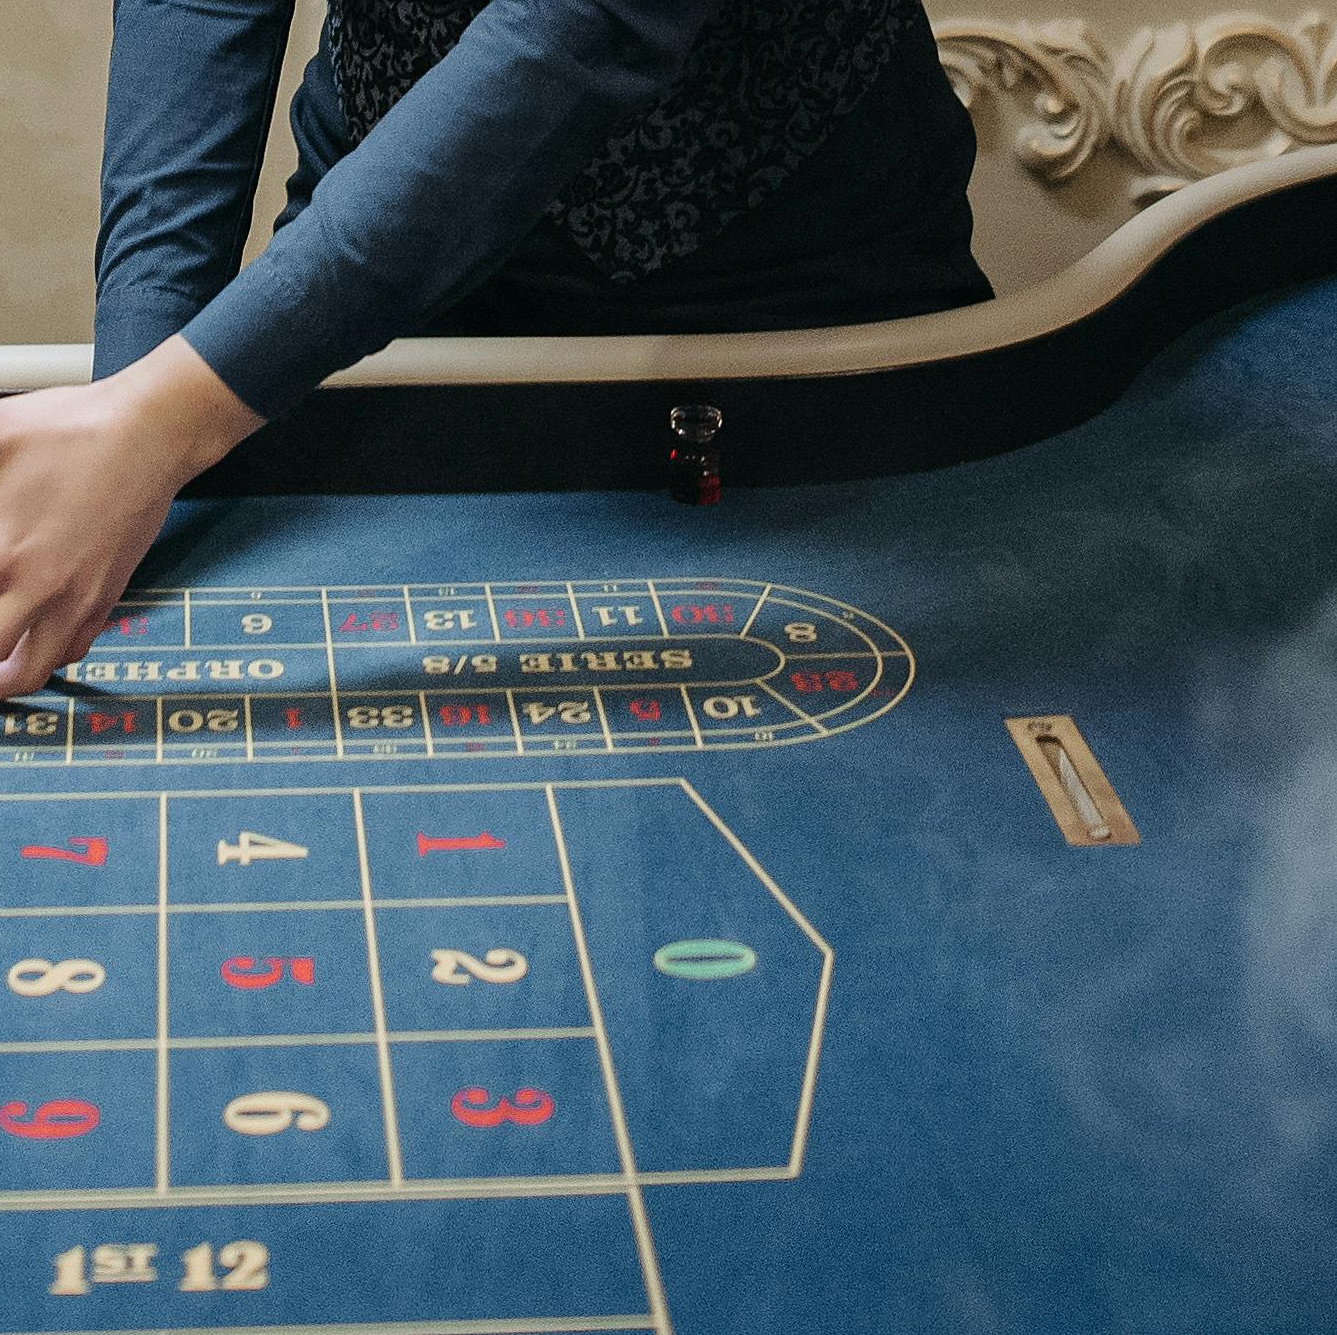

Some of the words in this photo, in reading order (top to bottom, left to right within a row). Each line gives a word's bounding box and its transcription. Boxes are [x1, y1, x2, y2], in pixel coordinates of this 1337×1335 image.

[106, 614, 147, 635] 3
[242, 614, 272, 634] 6
[339, 613, 398, 631] 27
[424, 610, 475, 631] 13
[504, 610, 564, 627] 36
[593, 606, 641, 626] 11
[671, 605, 732, 623] 30
[785, 623, 817, 642] 8
[423, 655, 497, 675] 5/8
[520, 650, 692, 673] SERIE
[283, 707, 304, 730] 1
[347, 706, 412, 728] 33
[440, 705, 489, 725] 16
[523, 702, 590, 724] 24
[629, 701, 660, 720] 5
[703, 696, 759, 719] 10
[4, 713, 58, 735] 31
[88, 712, 135, 733] 14
[168, 710, 237, 732] 20
[21, 838, 108, 865] 7
[216, 831, 308, 866] 4
[417, 833, 504, 855] 1
[431, 949, 528, 985] 2
[653, 940, 756, 979] 0
[7, 959, 105, 997] 8
[221, 957, 314, 989] 5
[223, 1091, 330, 1136] 6
[451, 1089, 553, 1127] 3
[50, 1244, 157, 1296] 1ST
[180, 1241, 268, 1292] 12
